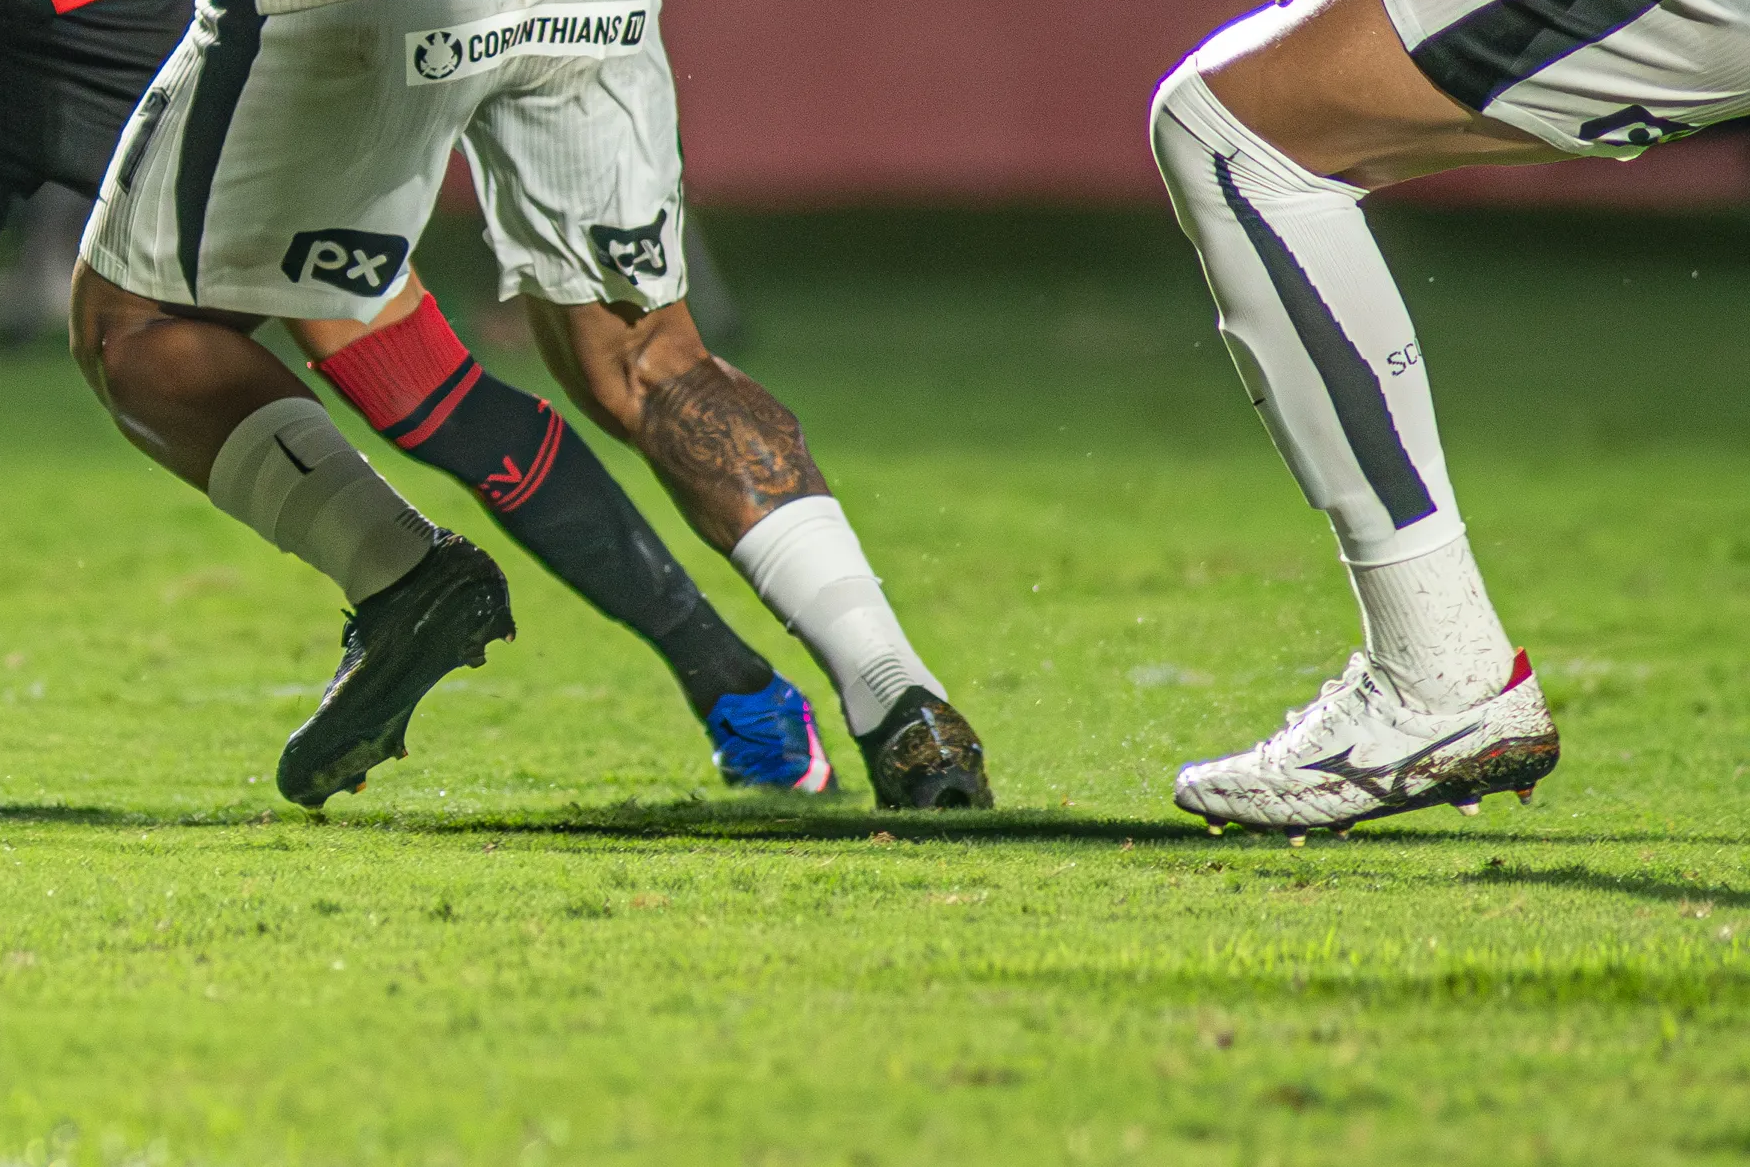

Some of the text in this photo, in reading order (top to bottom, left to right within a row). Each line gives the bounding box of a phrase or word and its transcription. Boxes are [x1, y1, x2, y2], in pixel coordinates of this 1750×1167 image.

[467, 12, 645, 63] CORINTHIANS TV
[296, 240, 387, 288] px
